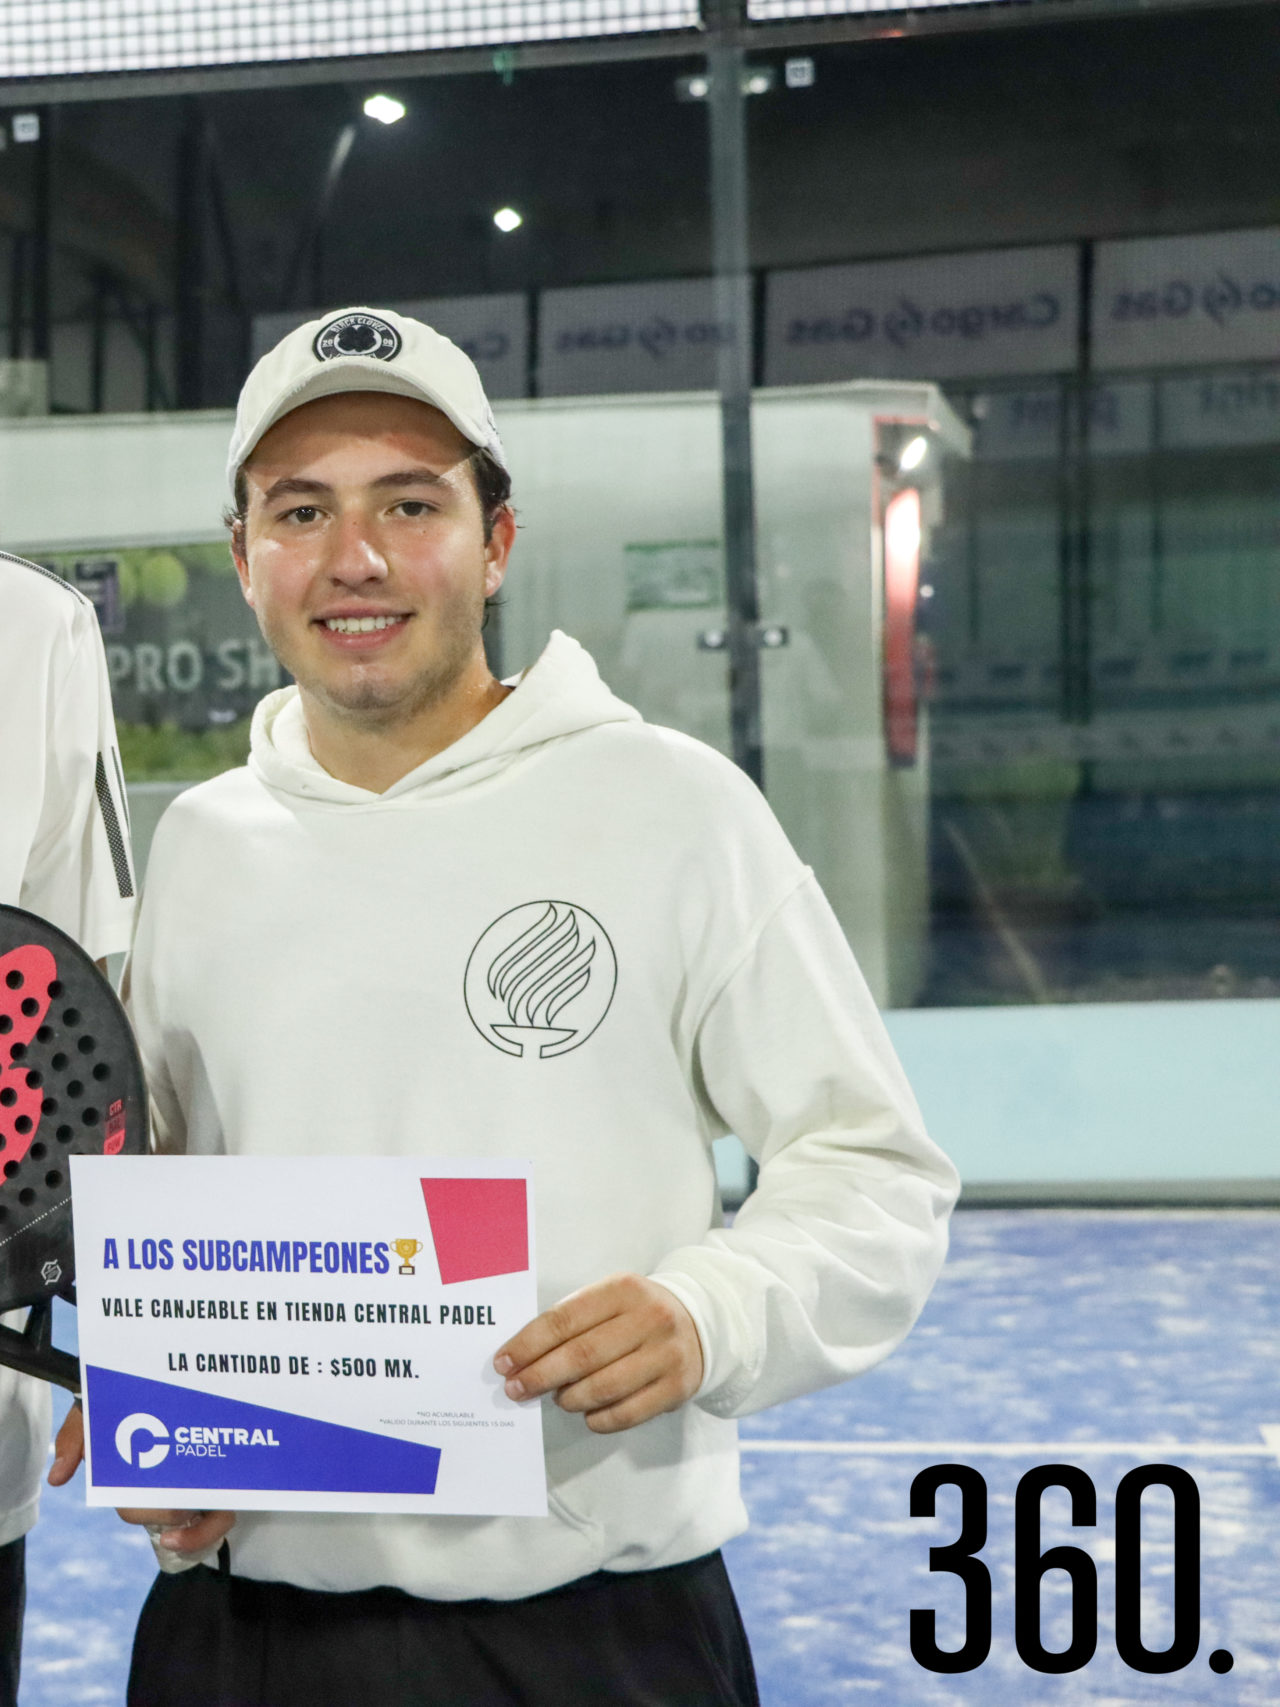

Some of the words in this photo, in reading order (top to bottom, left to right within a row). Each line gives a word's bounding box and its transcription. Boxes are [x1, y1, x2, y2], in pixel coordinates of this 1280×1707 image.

[108, 641, 204, 693] PRO
[103, 1238, 120, 1269] A
[127, 1238, 174, 1271] LOS
[182, 1239, 390, 1275] SUBCAMPEONES
[101, 1297, 143, 1318] VALE
[150, 1298, 249, 1320] CANJEABLE
[256, 1301, 278, 1321] EN
[284, 1301, 347, 1323] TIENDA
[354, 1303, 432, 1325] CENTRAL
[439, 1304, 496, 1326] PADEL
[168, 1352, 189, 1372] LA
[195, 1353, 281, 1375] CANTIDAD
[288, 1356, 310, 1376] DE
[330, 1357, 377, 1378] $500
[384, 1358, 419, 1379] MX.
[407, 1419, 437, 1427] DURANTE
[452, 1420, 489, 1428] SIGUIENTES
[432, 1411, 475, 1419] ACUMULABLE
[174, 1426, 280, 1447] CENTRAL
[176, 1443, 227, 1458] PADEL
